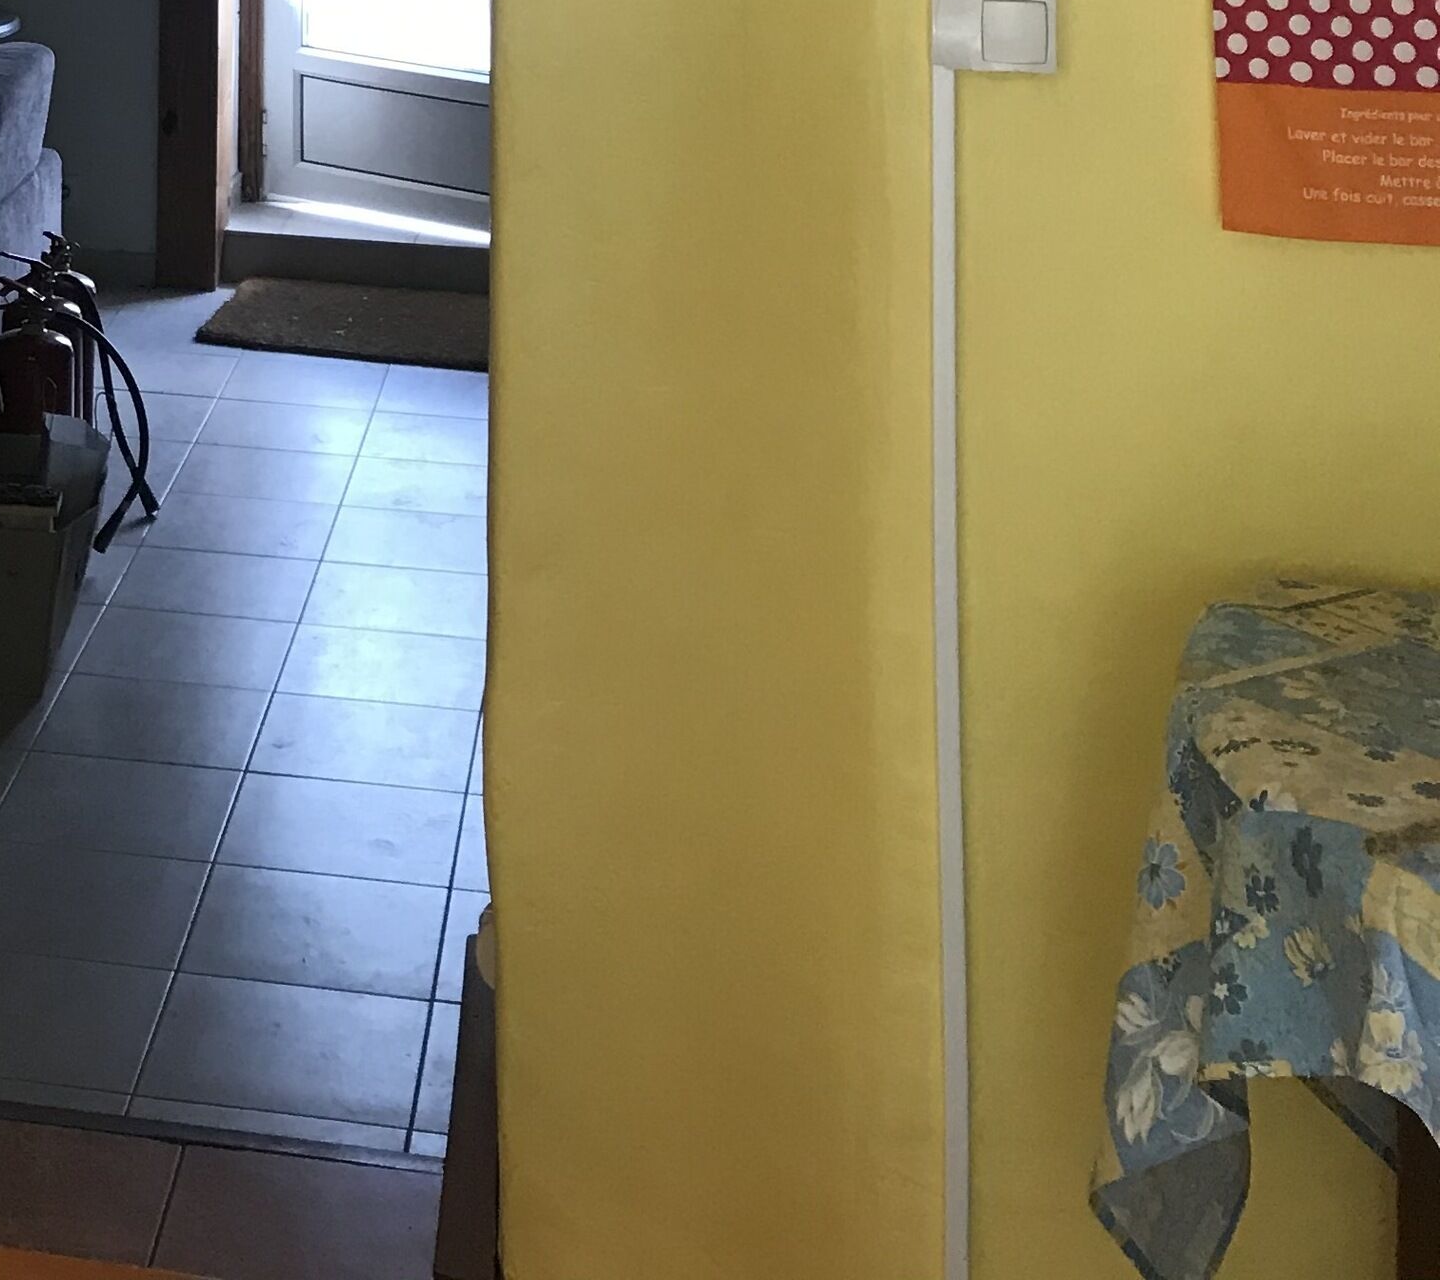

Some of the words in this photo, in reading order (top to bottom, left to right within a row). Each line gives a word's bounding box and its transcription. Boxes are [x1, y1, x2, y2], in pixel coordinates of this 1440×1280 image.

[1288, 126, 1327, 141] Laver
[1331, 132, 1347, 144] et
[1351, 132, 1388, 145] vider
[1392, 132, 1406, 146] le
[1409, 134, 1435, 147] bar
[1322, 149, 1368, 165] Placer
[1373, 151, 1385, 166] le
[1389, 153, 1414, 167] bar
[1380, 175, 1432, 190] Mettre
[1303, 187, 1328, 200] Une
[1332, 187, 1361, 203] fois
